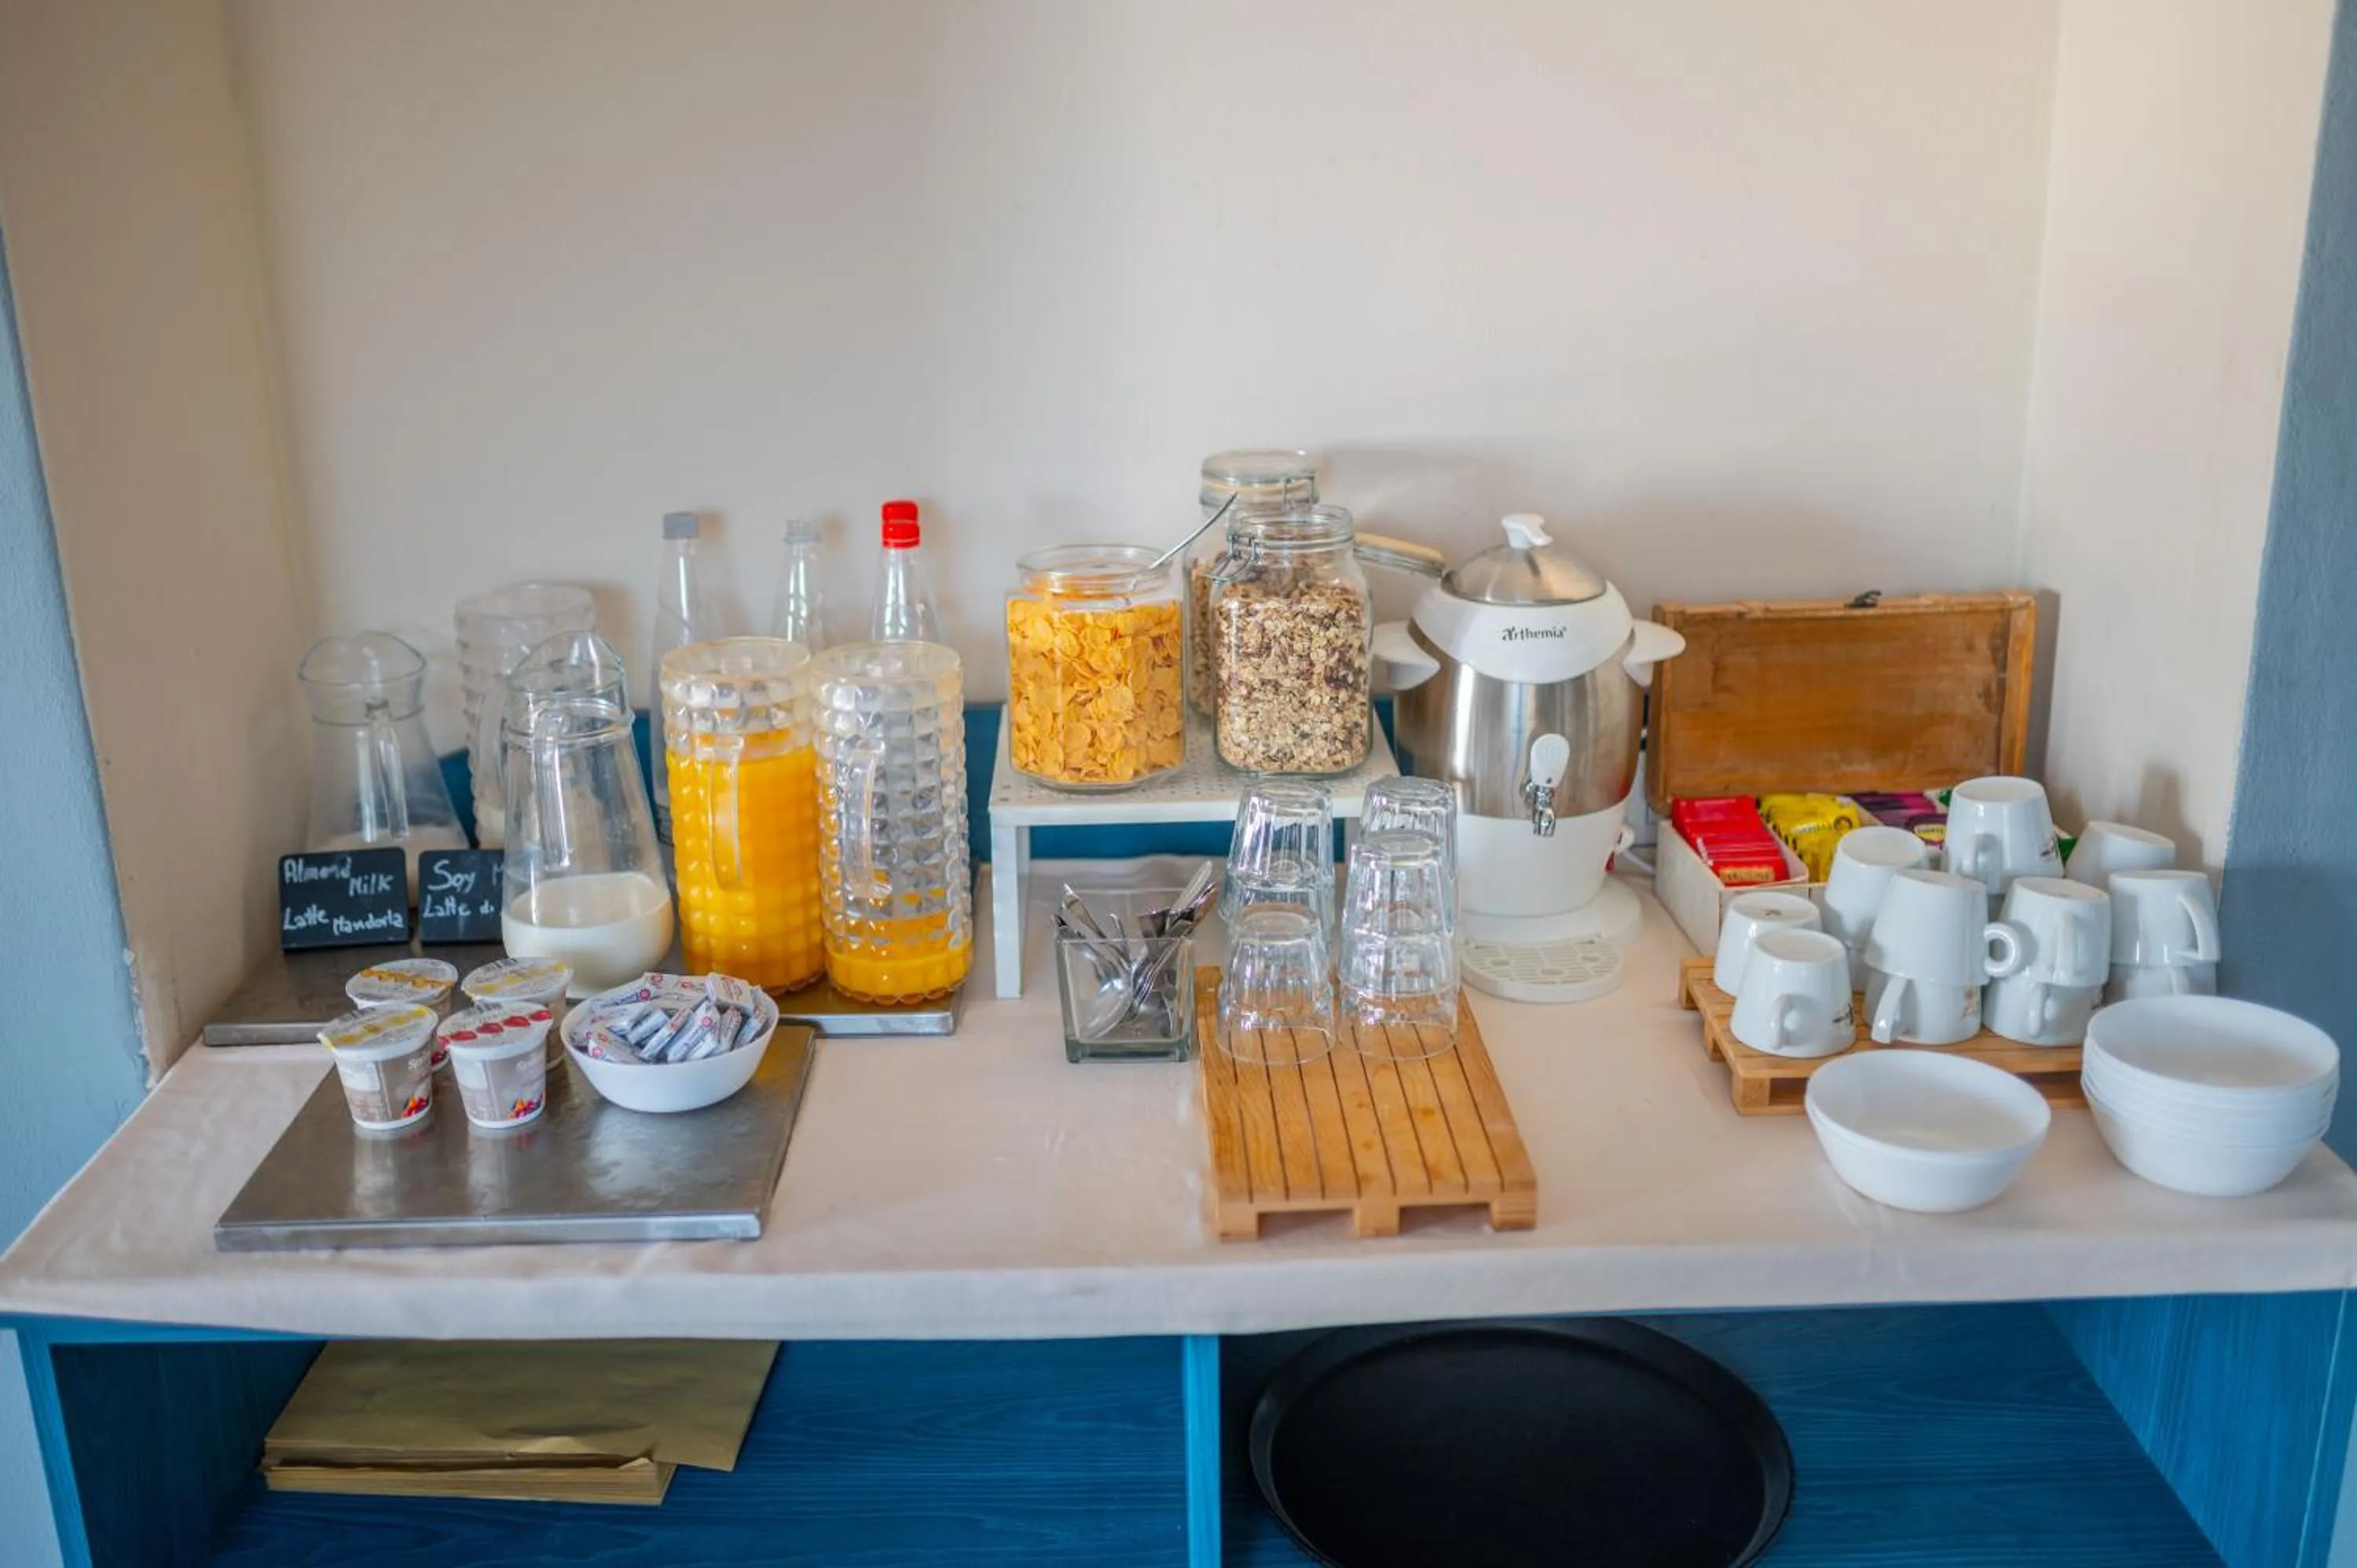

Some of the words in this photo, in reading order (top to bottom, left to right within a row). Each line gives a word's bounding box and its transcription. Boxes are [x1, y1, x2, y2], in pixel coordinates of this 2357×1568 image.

[284, 855, 352, 883] Almond
[427, 859, 476, 893] Soy
[283, 905, 330, 930] Latte
[332, 909, 404, 936] Mandorla
[423, 894, 471, 918] Latte
